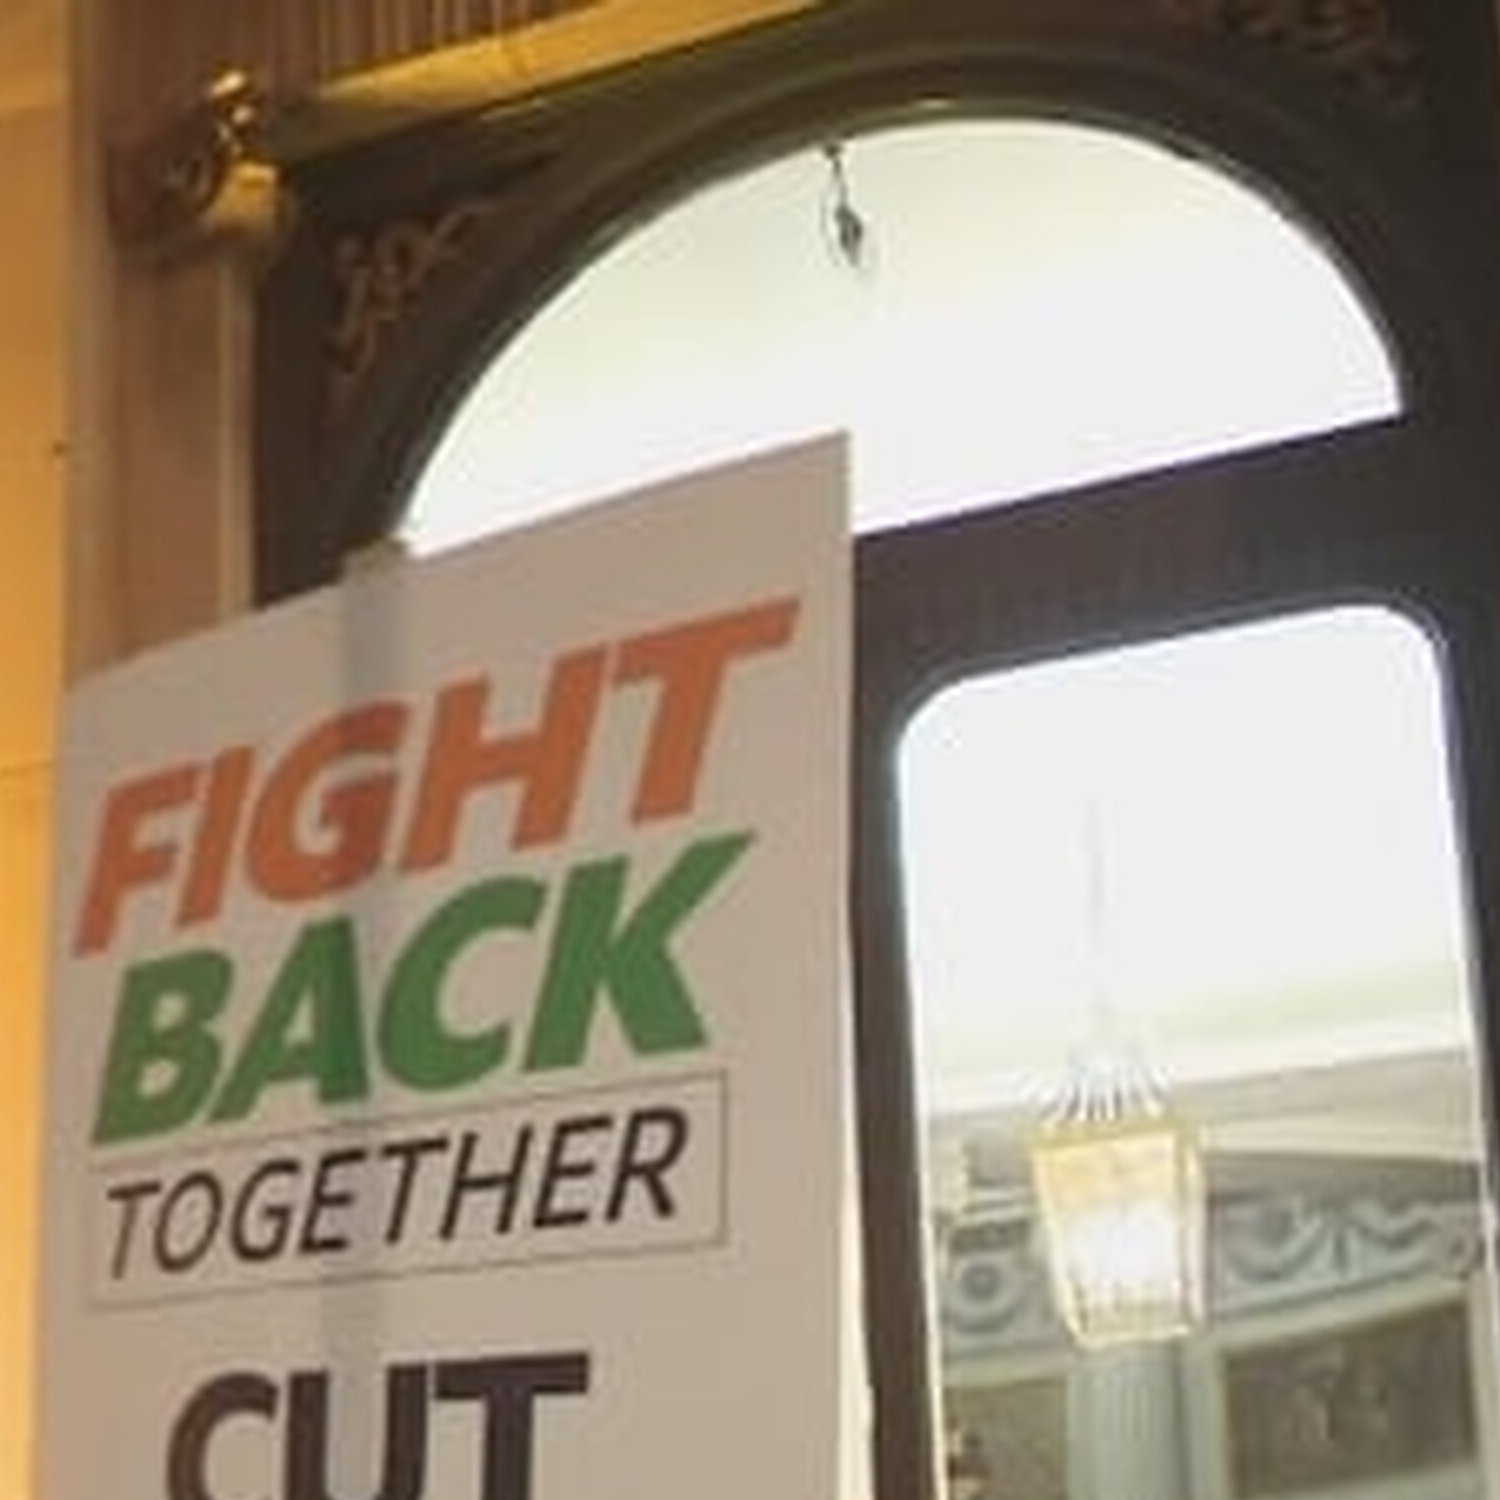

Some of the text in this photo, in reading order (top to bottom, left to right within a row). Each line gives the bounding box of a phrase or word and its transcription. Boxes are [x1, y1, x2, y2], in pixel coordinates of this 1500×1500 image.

[73, 597, 803, 959] FIGHT
[92, 830, 757, 1148] BACK
[105, 1105, 690, 1281] TOGETHER
